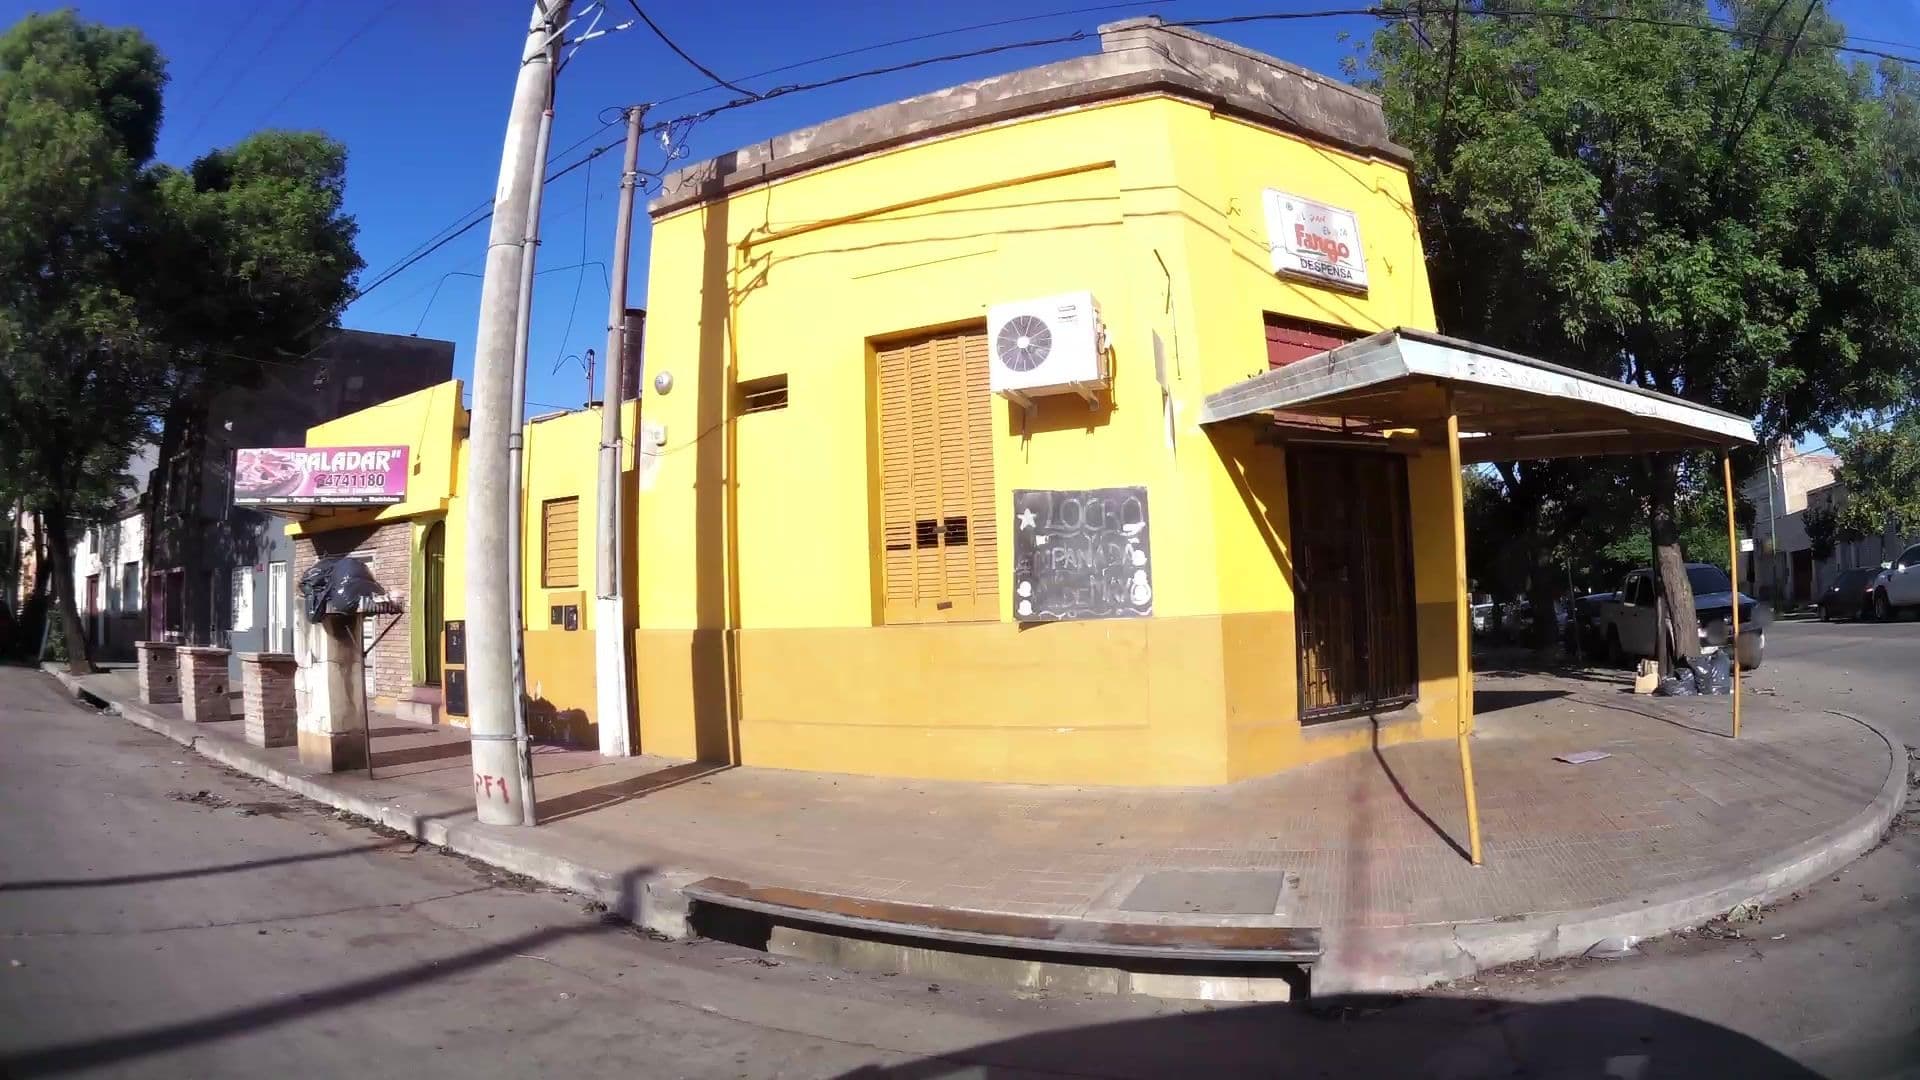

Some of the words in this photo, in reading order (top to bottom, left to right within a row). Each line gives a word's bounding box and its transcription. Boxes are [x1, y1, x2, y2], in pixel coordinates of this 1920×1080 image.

[1295, 223, 1350, 264] Fango
[1300, 258, 1353, 279] DESPENSA
[325, 474, 385, 488] 4741180
[474, 773, 510, 804] PF1
